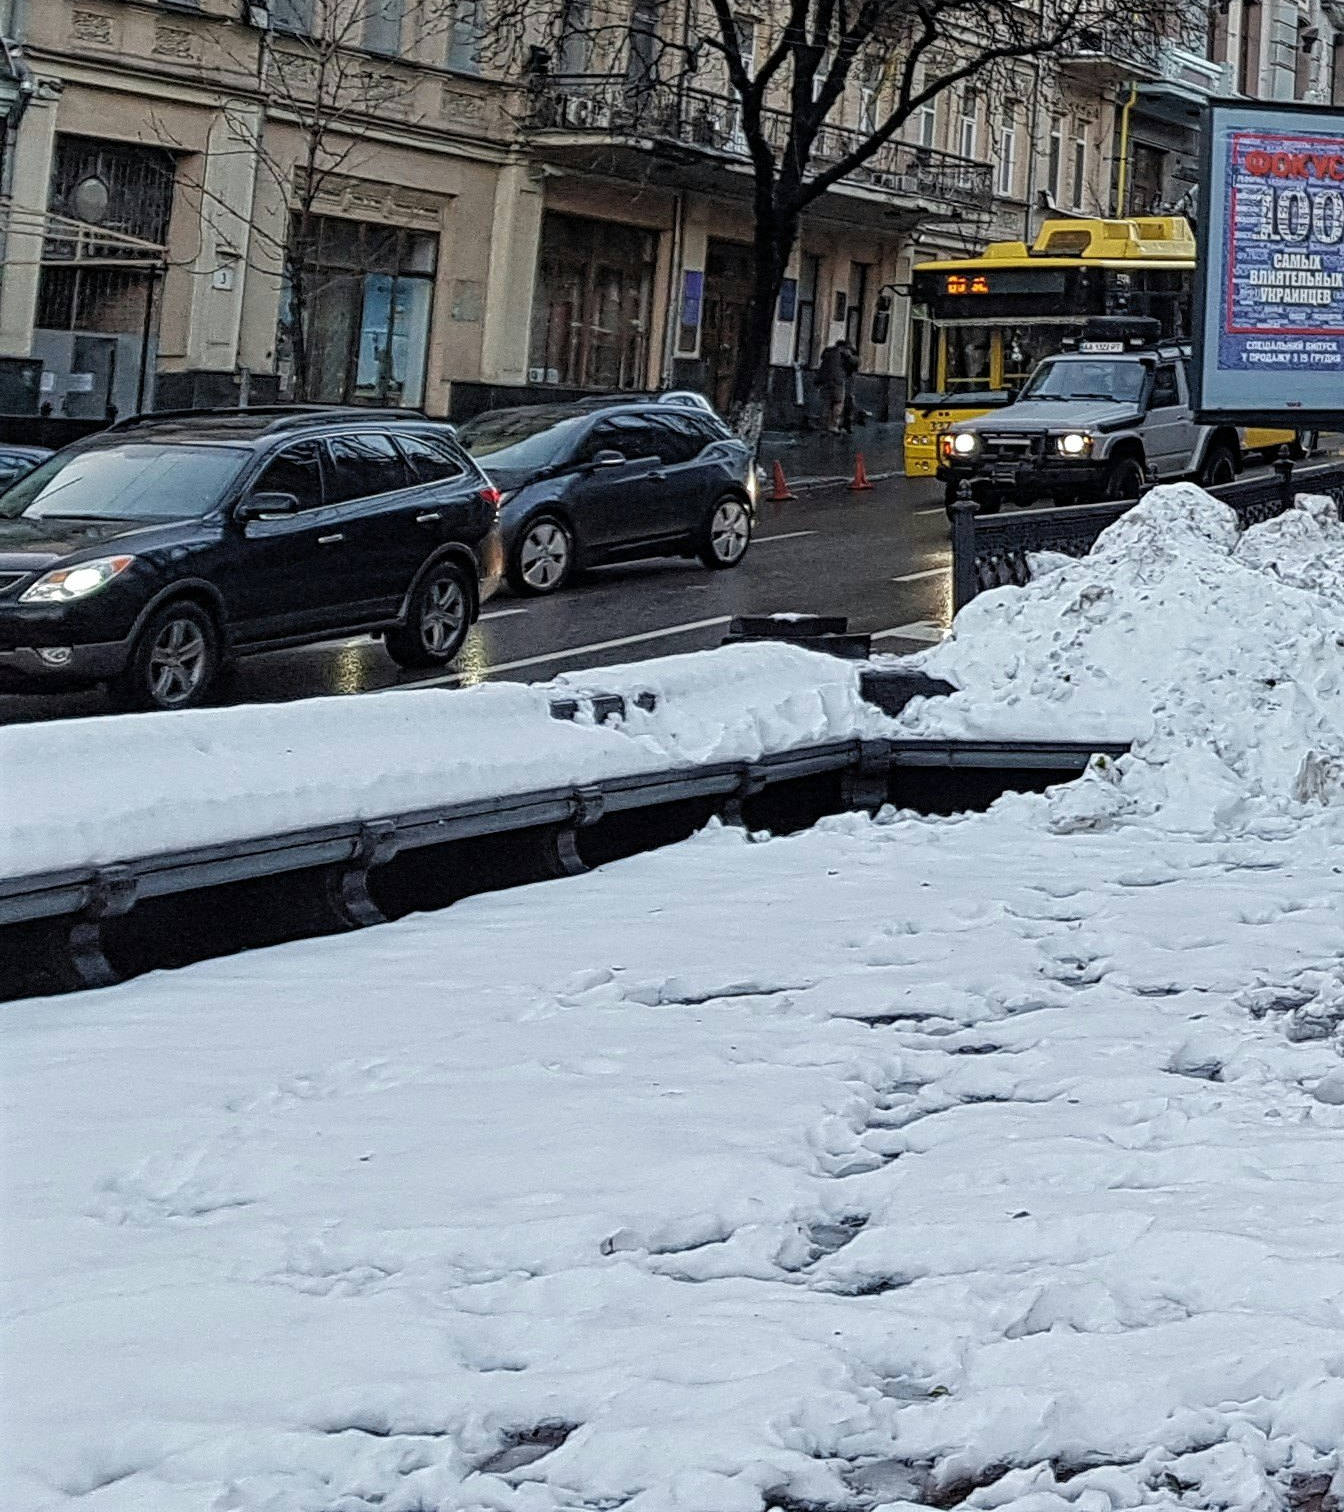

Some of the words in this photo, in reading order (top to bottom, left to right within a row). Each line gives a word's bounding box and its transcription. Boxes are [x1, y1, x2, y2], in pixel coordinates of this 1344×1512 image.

[1272, 253, 1322, 270] САМЫХ
[1248, 269, 1344, 288] ВЛИЯТЕЛЬНЫХ
[1260, 287, 1332, 307] УКРАИНЦЕВ
